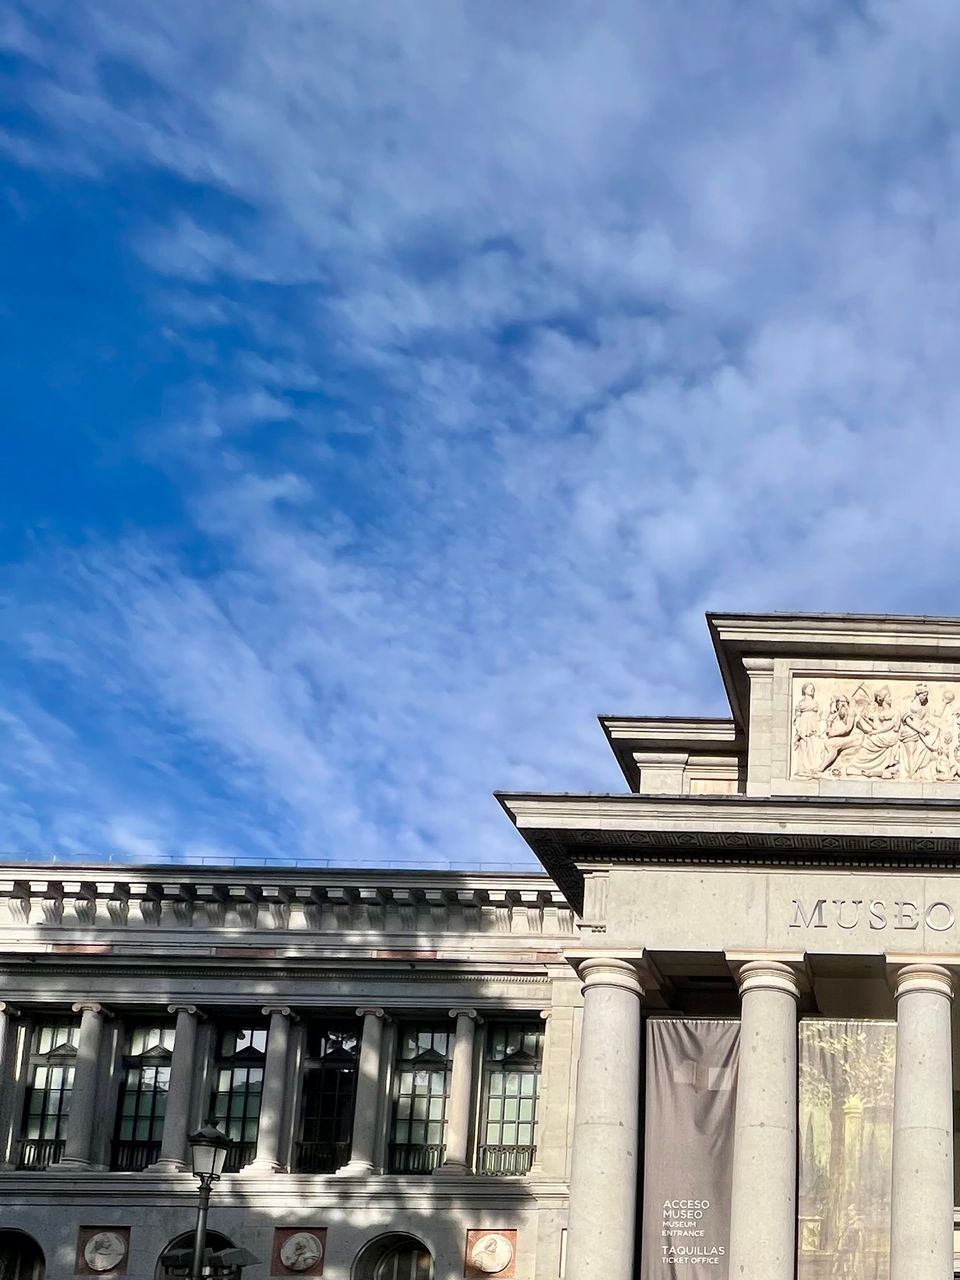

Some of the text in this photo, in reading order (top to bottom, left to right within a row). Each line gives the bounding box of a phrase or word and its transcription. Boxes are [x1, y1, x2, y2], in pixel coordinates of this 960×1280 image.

[788, 899, 956, 932] MUSEO
[663, 1199, 710, 1209] ACCESO
[663, 1209, 703, 1219] MUSEO
[662, 1220, 697, 1228] MUSEUM
[661, 1229, 705, 1237] ENTRANCE
[662, 1245, 725, 1255] TAQUILLAS
[662, 1256, 689, 1264] TICKET
